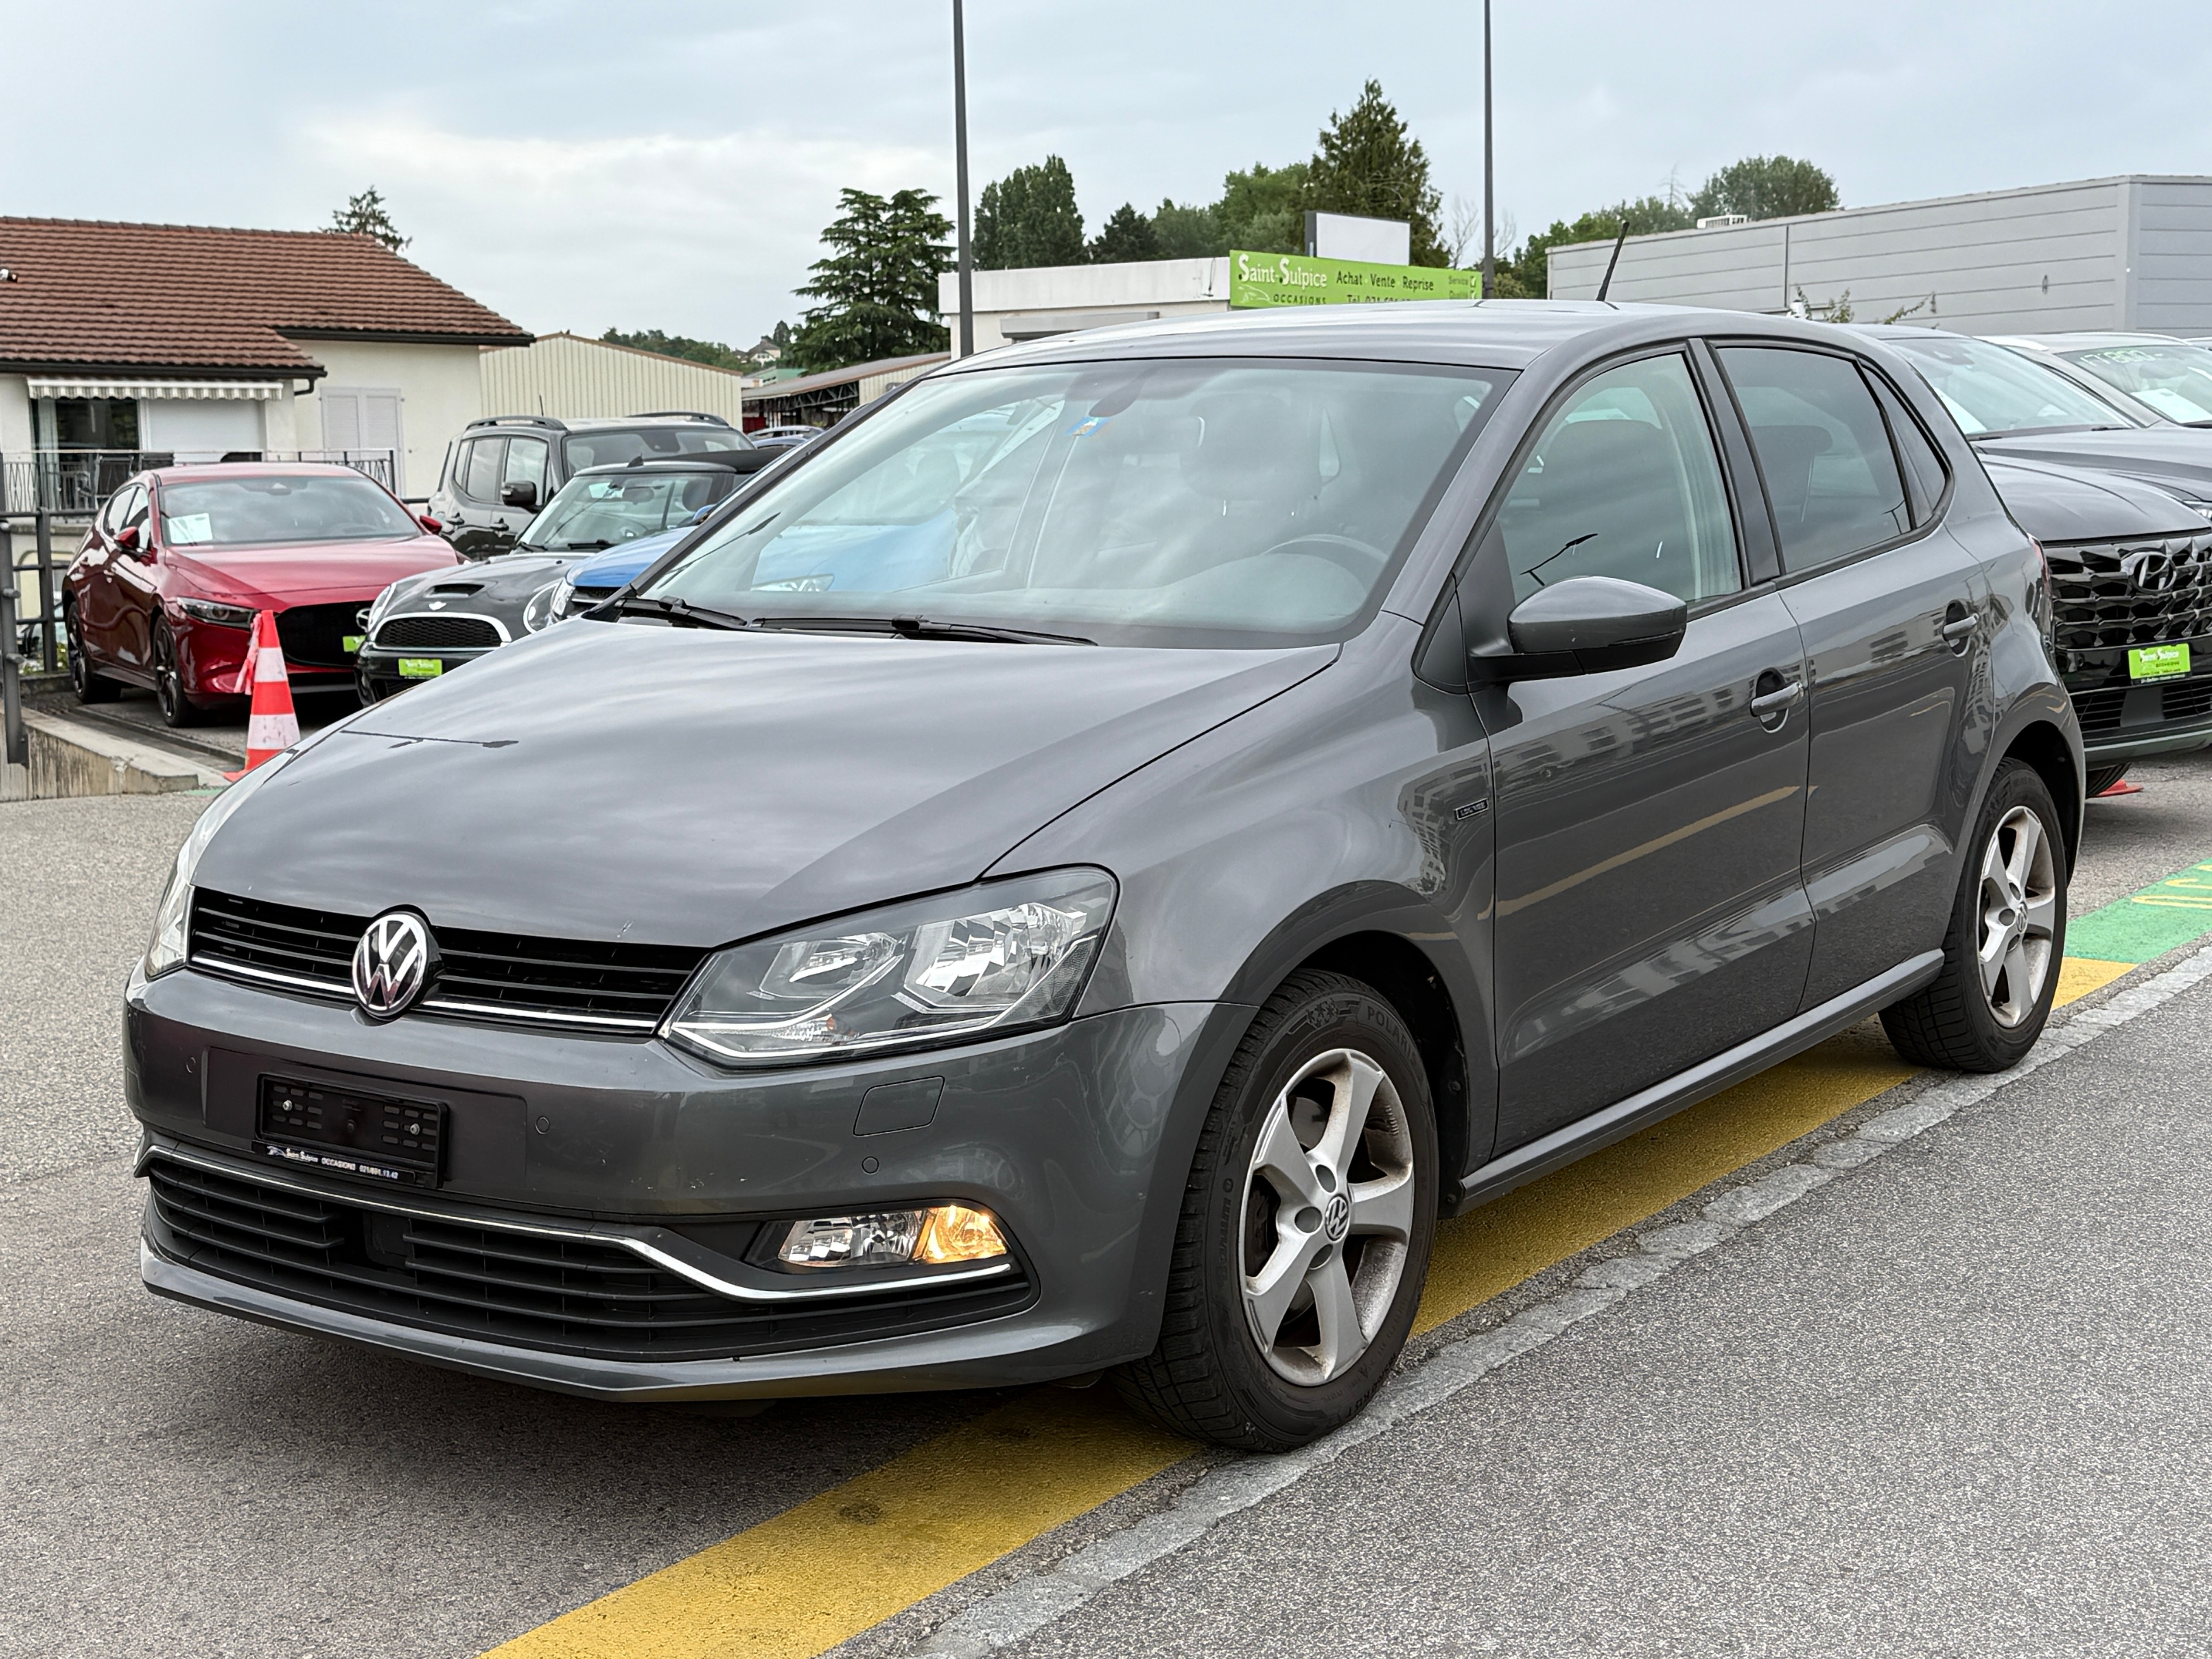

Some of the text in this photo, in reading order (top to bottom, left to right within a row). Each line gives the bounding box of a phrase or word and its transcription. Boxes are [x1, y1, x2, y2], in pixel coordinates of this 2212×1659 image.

[1239, 254, 1327, 290] Saint-Sulpice
[1336, 271, 1434, 292] Achat Vente Reprise
[1273, 294, 1326, 305] OCCASIONS
[1367, 1005, 1417, 1067] POLARIS
